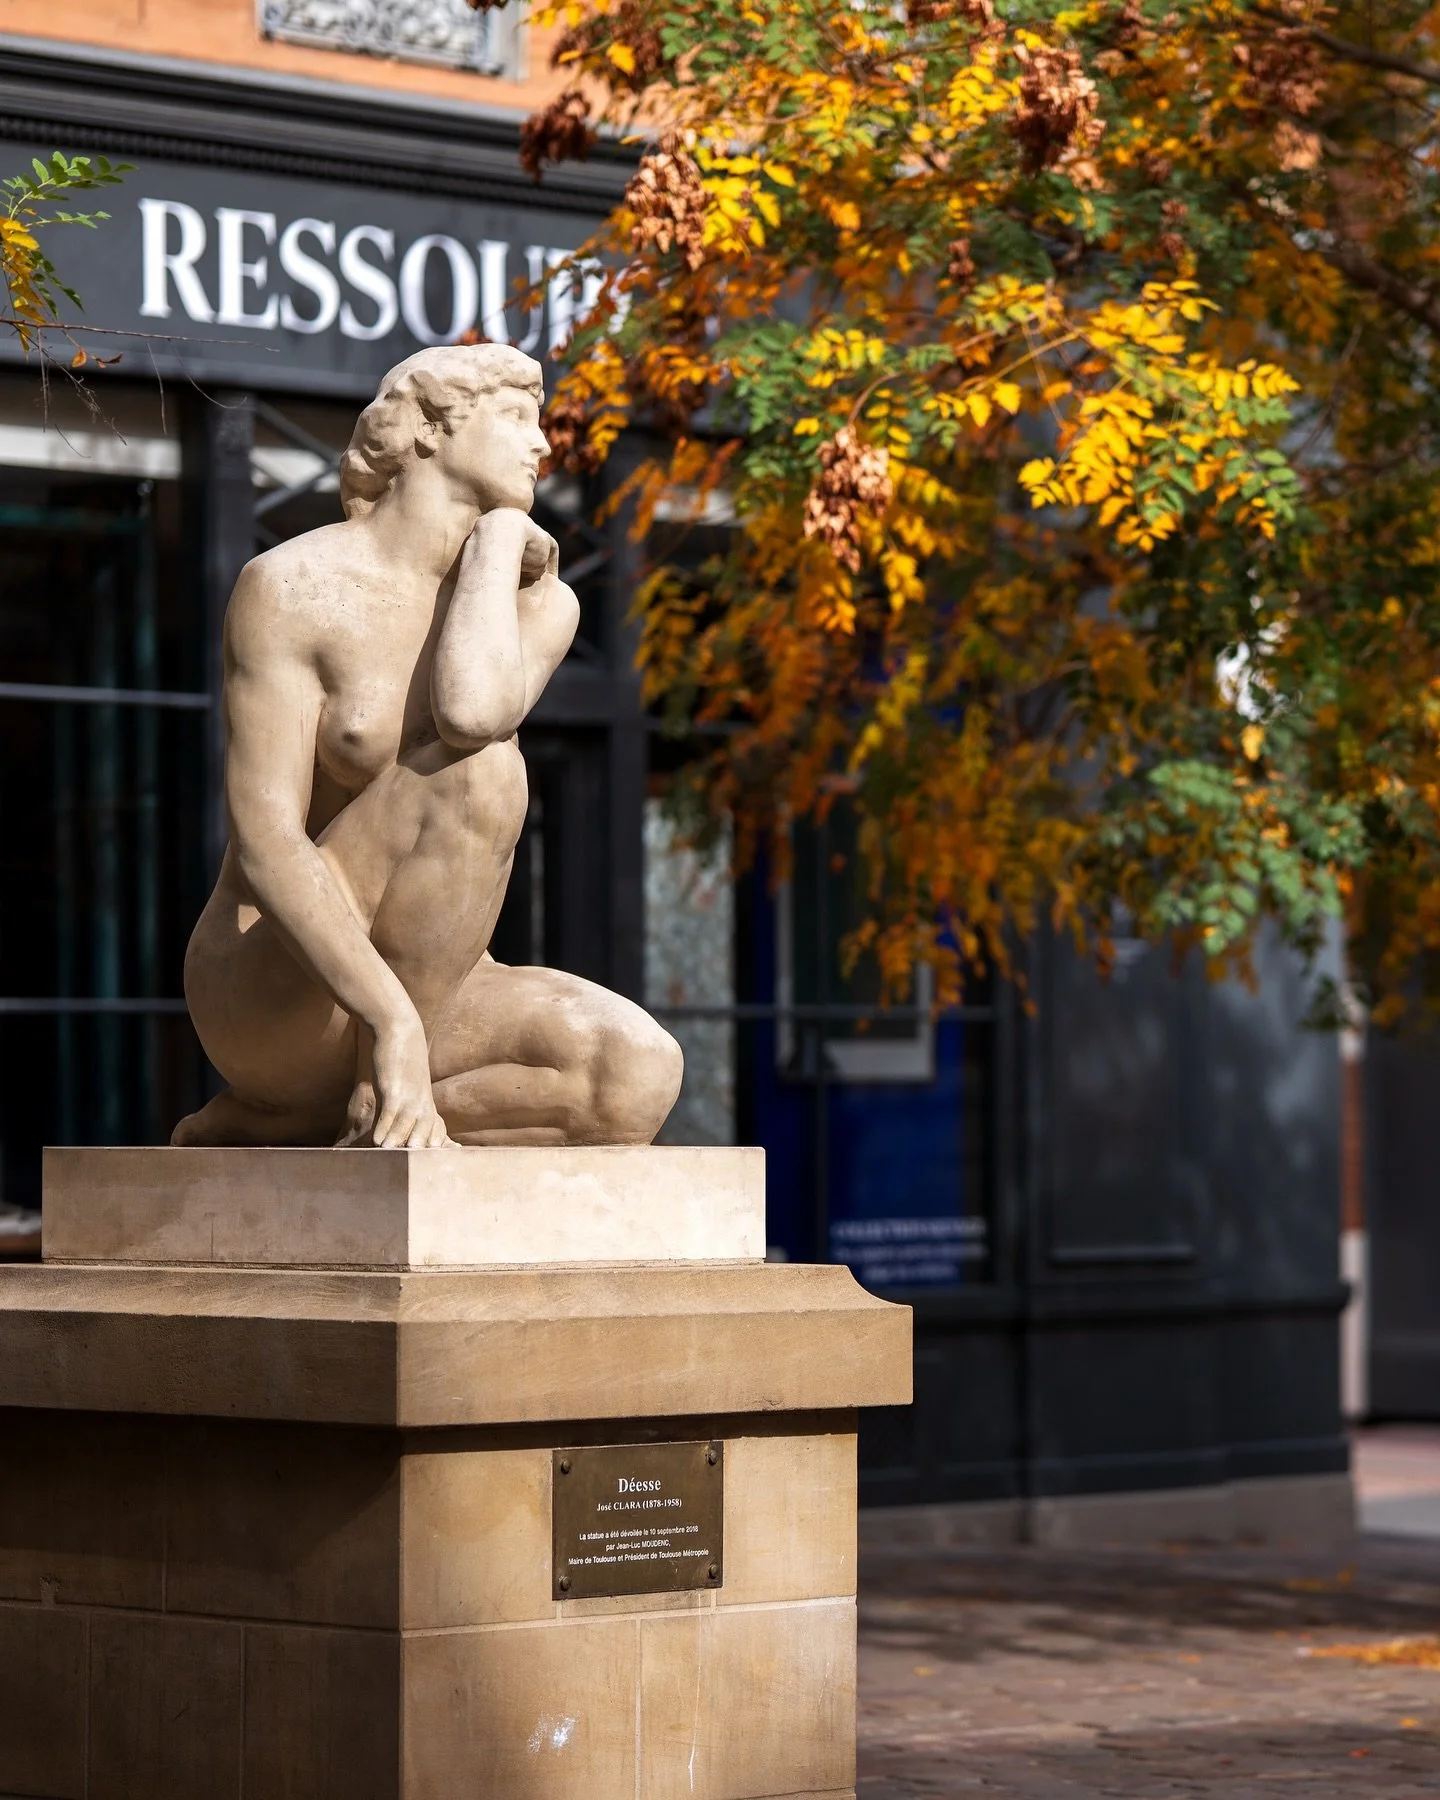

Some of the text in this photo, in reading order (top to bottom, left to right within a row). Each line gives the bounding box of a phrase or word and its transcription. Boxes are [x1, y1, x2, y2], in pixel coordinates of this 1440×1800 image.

[618, 1477, 661, 1492] Déesse
[597, 1498, 682, 1511] José CLARA (1878-1958)
[587, 1532, 604, 1540] statue
[610, 1530, 619, 1538] été
[620, 1529, 642, 1537] dévoilée
[657, 1526, 685, 1536] septembre
[642, 1539, 671, 1548] MOUDENC,
[683, 1548, 709, 1557] Métropole
